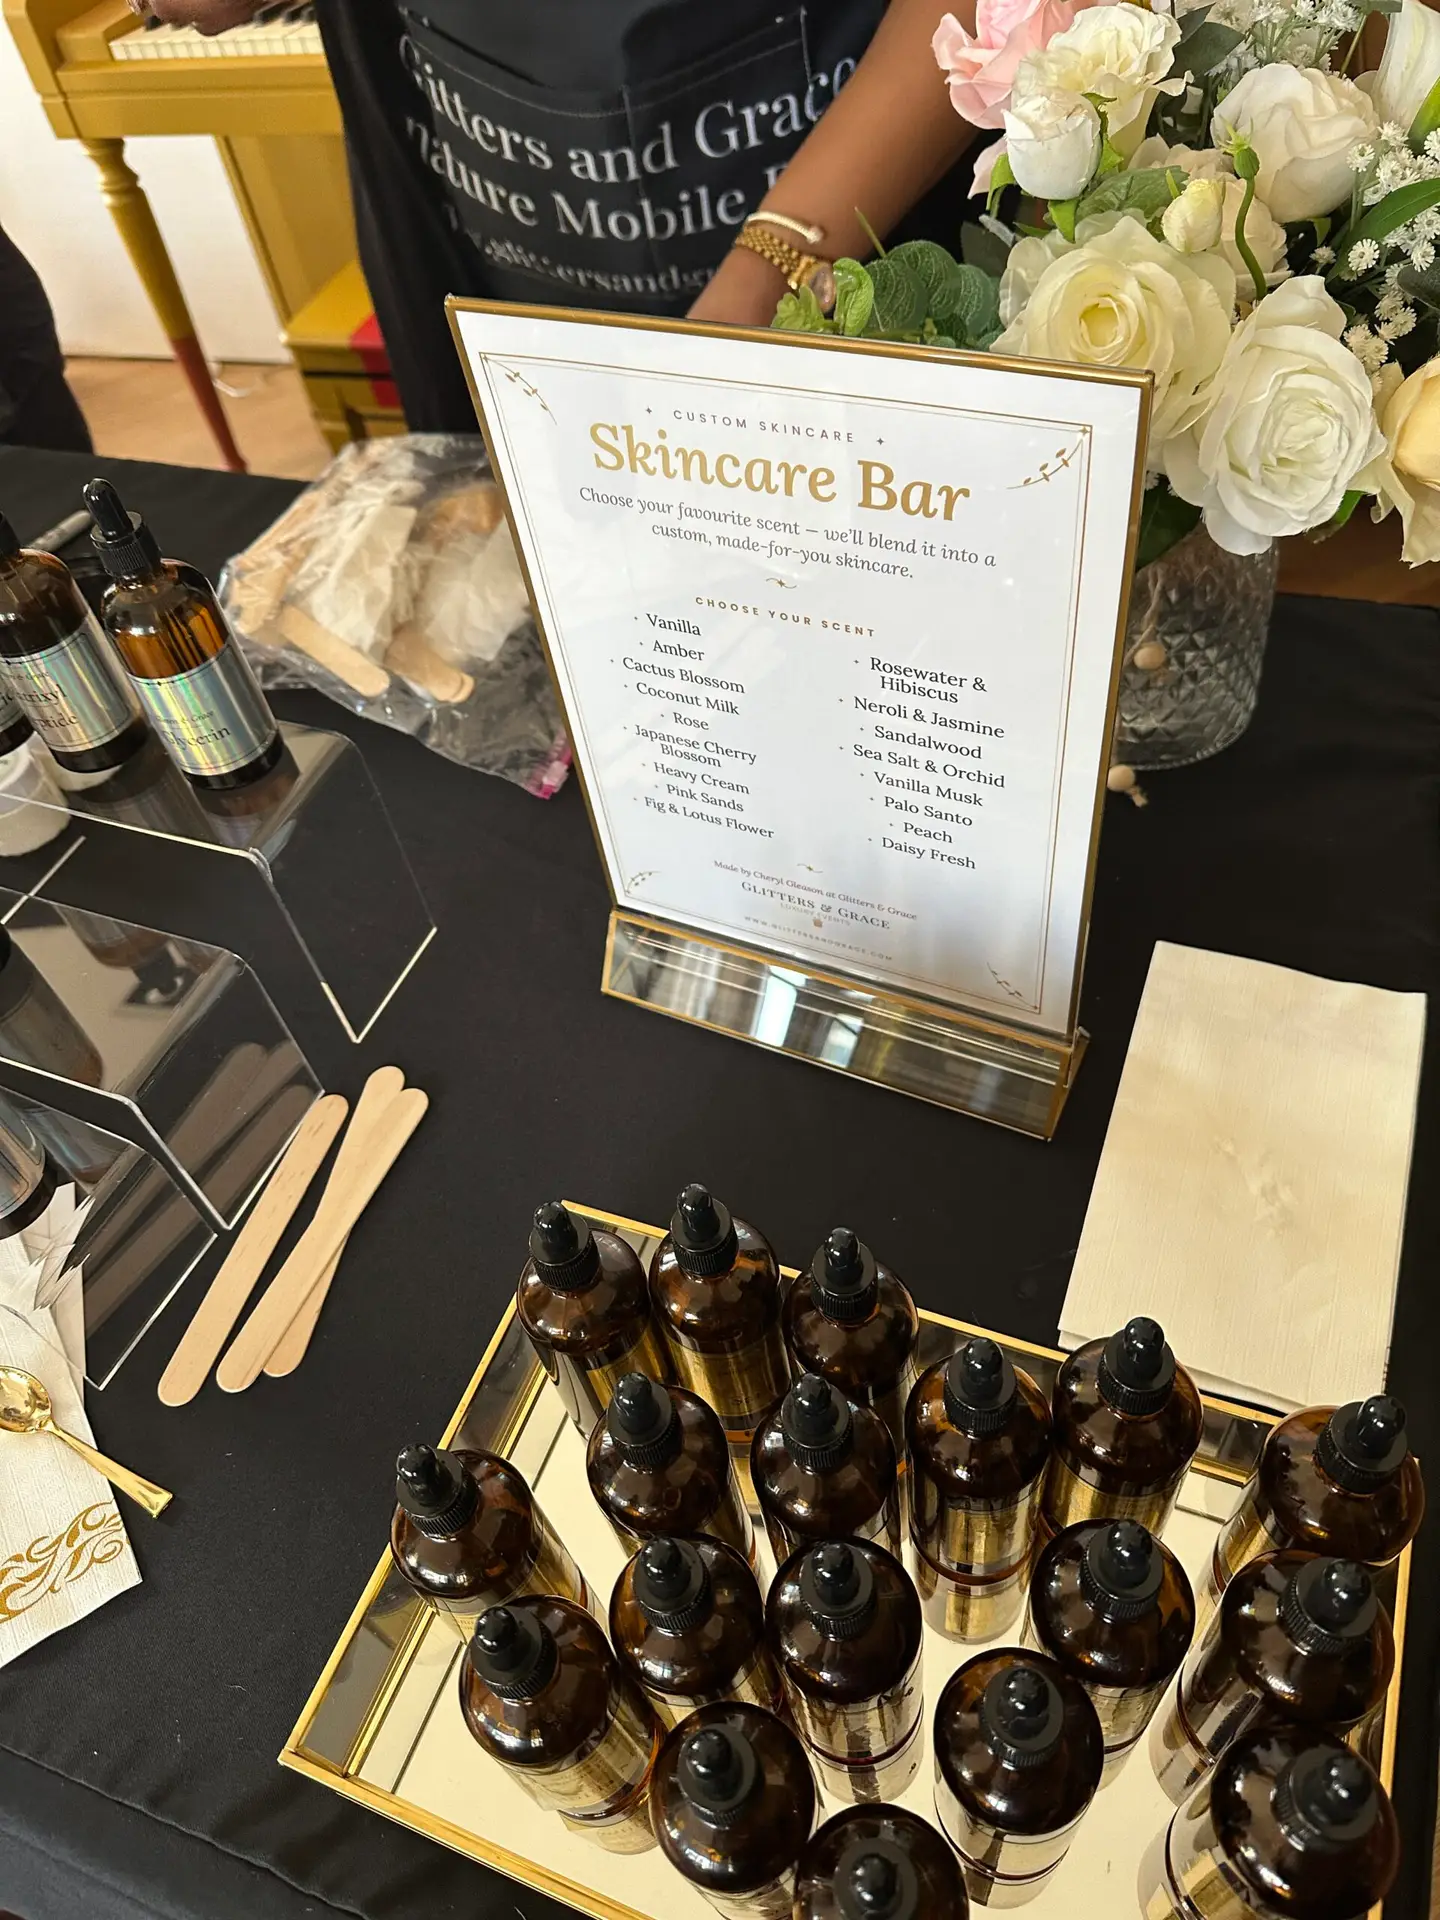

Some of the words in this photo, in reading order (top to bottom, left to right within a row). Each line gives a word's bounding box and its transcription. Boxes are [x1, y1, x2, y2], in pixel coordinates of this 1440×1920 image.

[568, 120, 680, 183] and
[551, 185, 746, 242] Mobile
[673, 409, 748, 429] CUSTOM
[759, 421, 855, 444] SKINCARE
[588, 422, 837, 503] Skincare
[857, 459, 971, 523] Bar
[579, 486, 635, 509] Choose
[636, 496, 674, 516] your
[676, 502, 752, 529] favourite
[756, 516, 800, 537] scent
[868, 531, 918, 554] blend
[921, 539, 936, 557] it
[941, 544, 980, 564] into
[984, 554, 997, 567] a
[651, 522, 712, 548] custom,
[716, 532, 832, 568] made-for-you
[835, 552, 913, 579] skincare.
[646, 613, 701, 636] Vanilla
[696, 597, 759, 616] CHOOSE
[769, 610, 811, 625] YOUR
[821, 620, 875, 637] SCENT
[653, 640, 705, 661] Amber
[623, 657, 676, 679] Cactus
[679, 668, 745, 694] Blossom
[870, 657, 967, 688] Rosewater
[972, 676, 988, 692] &
[880, 675, 959, 703] Hibiscus
[636, 682, 702, 707] Coconut
[706, 696, 740, 715] Milk
[673, 712, 709, 730] Rose
[854, 696, 908, 719] Neroli
[912, 708, 927, 723] &
[930, 712, 1005, 738] Jasmine
[635, 724, 701, 749] Japanese
[704, 741, 757, 765] Cherry
[660, 743, 722, 767] Blossom
[874, 725, 983, 759] Sandalwood
[654, 762, 698, 784] Heavy
[701, 773, 750, 795] Cream
[853, 744, 883, 761] Sea
[887, 751, 920, 769] Salt
[924, 760, 938, 773] &
[943, 764, 1005, 788] Orchid
[667, 783, 698, 801] Pink
[701, 792, 744, 812] Sands
[874, 771, 931, 795] Vanilla
[935, 785, 984, 807] Musk
[645, 796, 666, 813] Fig
[668, 803, 680, 815] &
[683, 806, 722, 826] Lotus
[726, 817, 775, 839] Flower
[884, 796, 920, 814] Palo
[924, 805, 973, 827] Santo
[903, 822, 953, 843] Peach
[882, 836, 926, 859] Daisy
[930, 849, 976, 869] Fresh
[714, 860, 739, 873] Made
[740, 867, 752, 878] by
[753, 871, 784, 886] Cheryl
[786, 880, 824, 896] Gleason
[825, 891, 836, 899] at
[838, 894, 875, 909] Glitters
[877, 904, 885, 912] &
[887, 906, 917, 920] Grace
[741, 881, 815, 909] GLITTERS
[820, 903, 832, 913] &
[838, 907, 890, 930] GRACE
